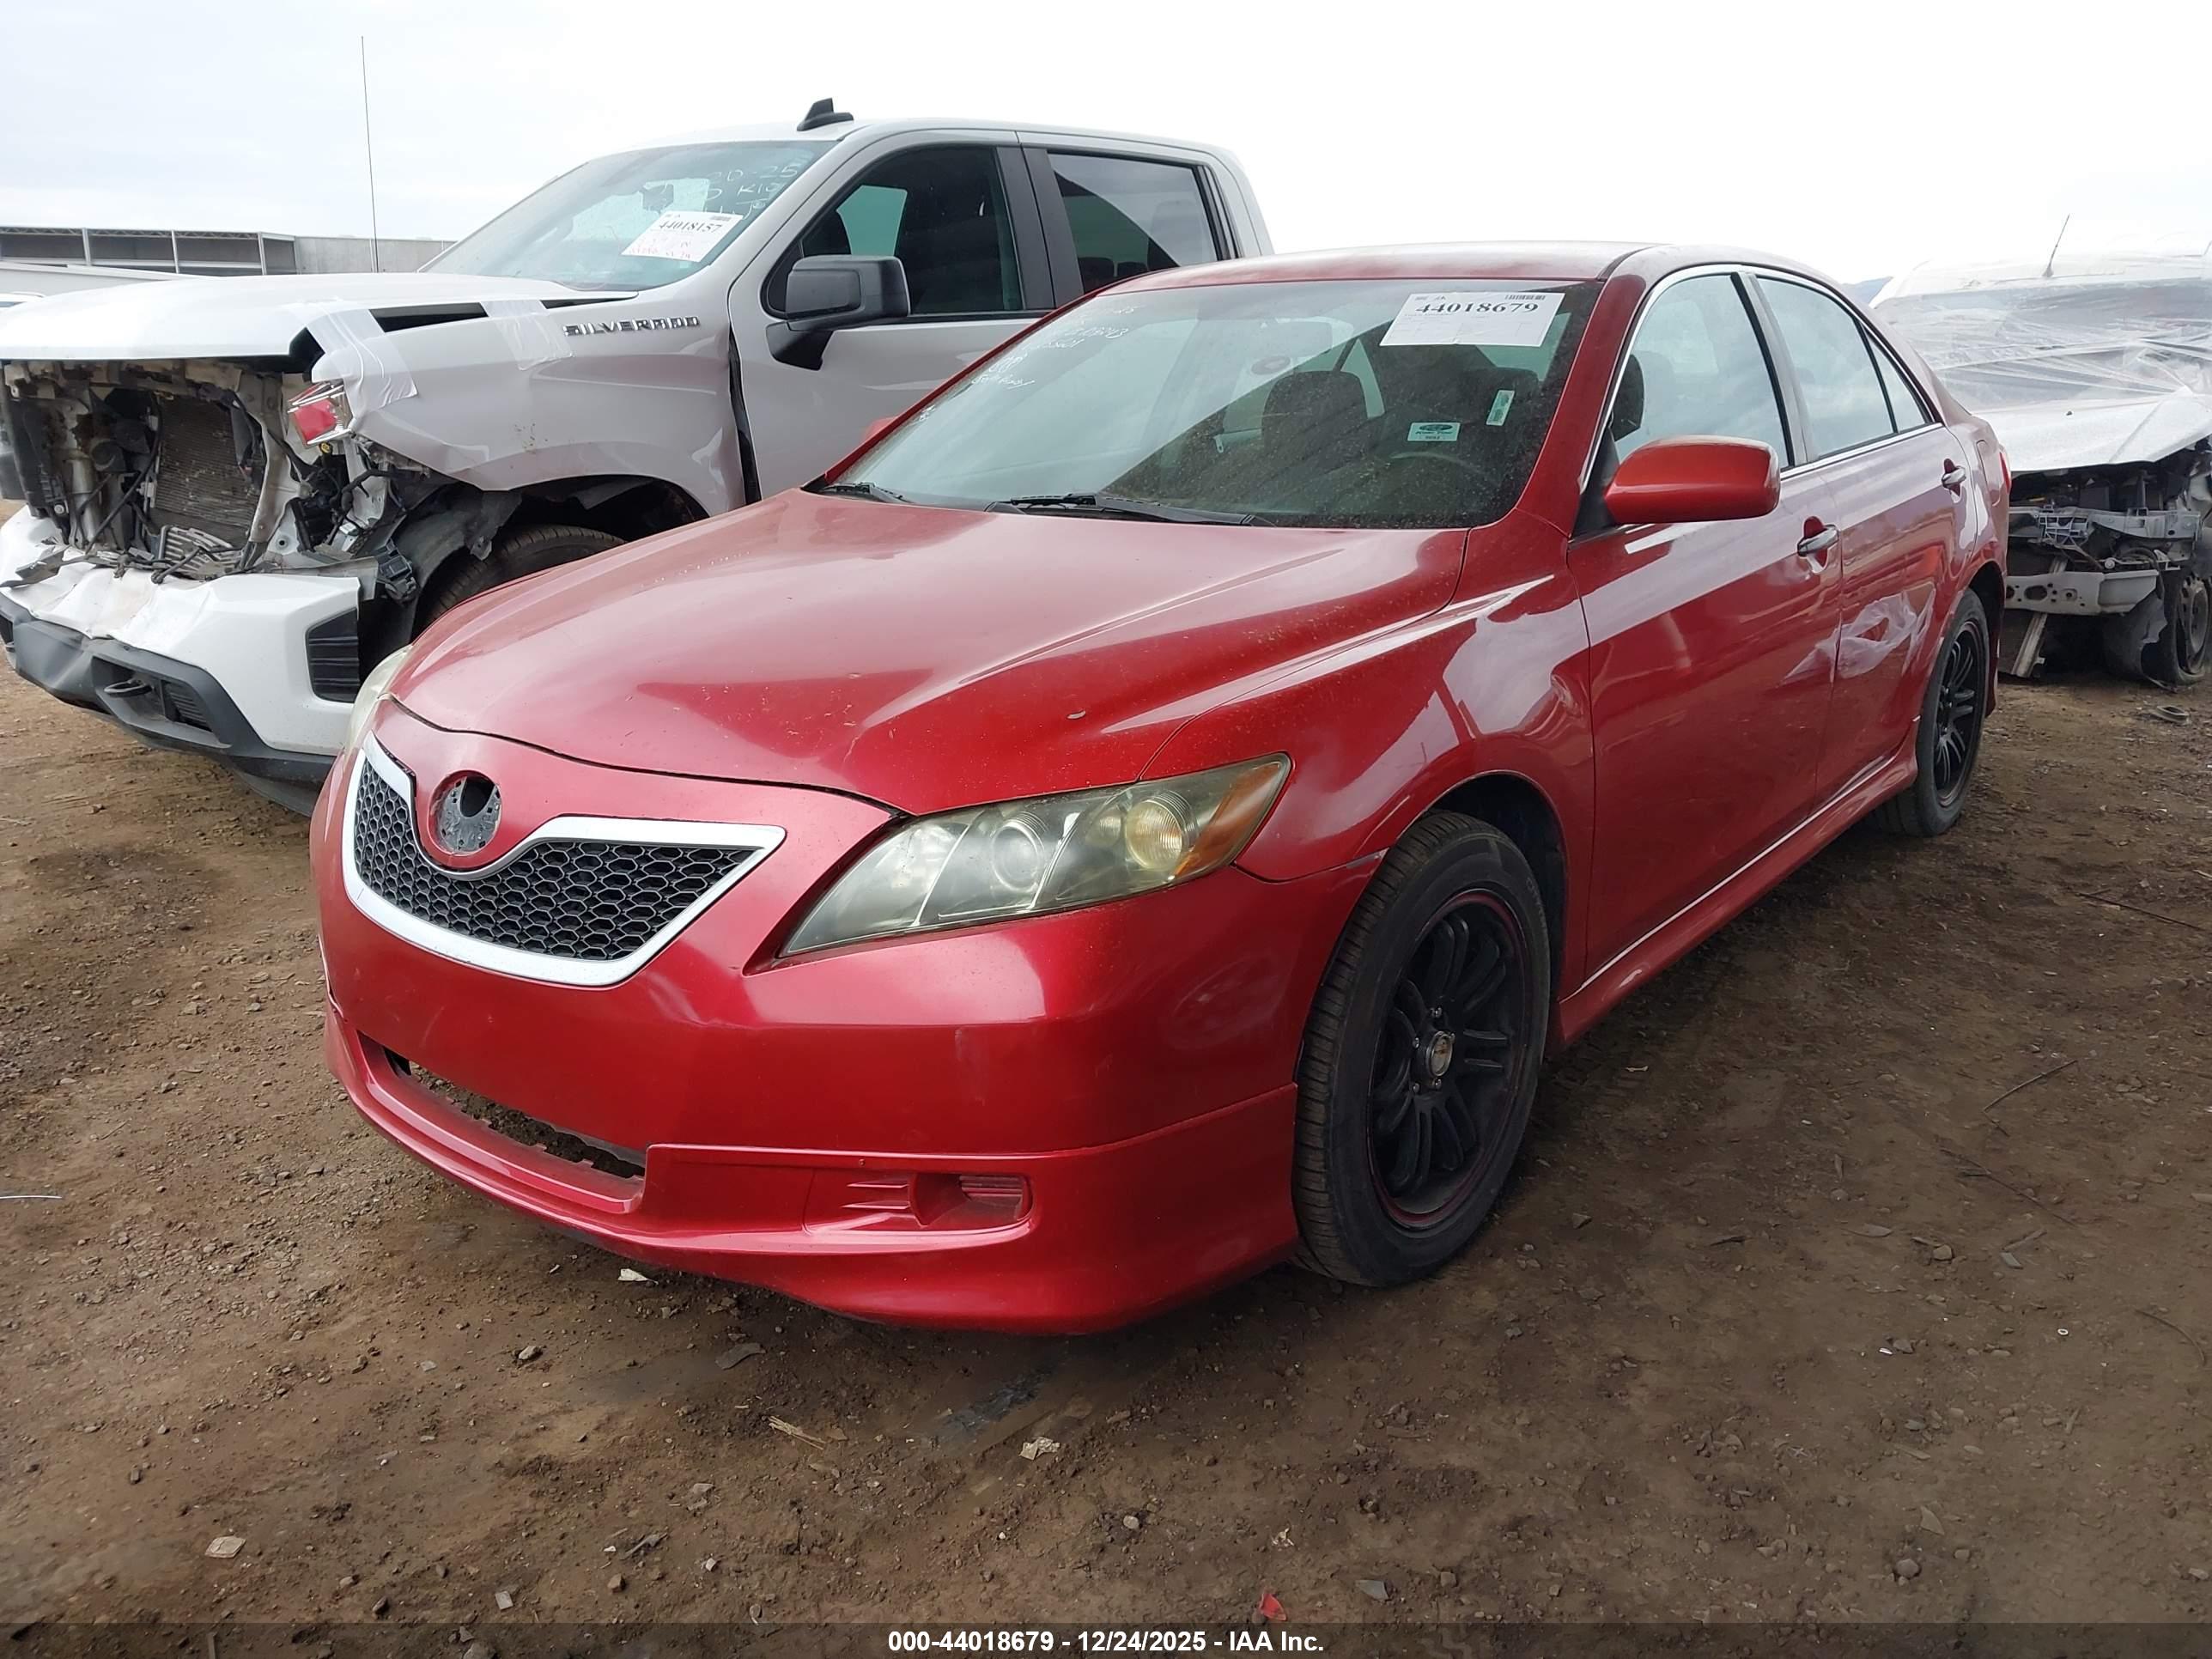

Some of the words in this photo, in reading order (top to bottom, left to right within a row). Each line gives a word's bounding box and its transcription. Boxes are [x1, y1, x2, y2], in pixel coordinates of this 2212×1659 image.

[659, 221, 722, 234] 44018157
[1415, 302, 1540, 314] 44018679
[562, 316, 700, 337] SILVERADO
